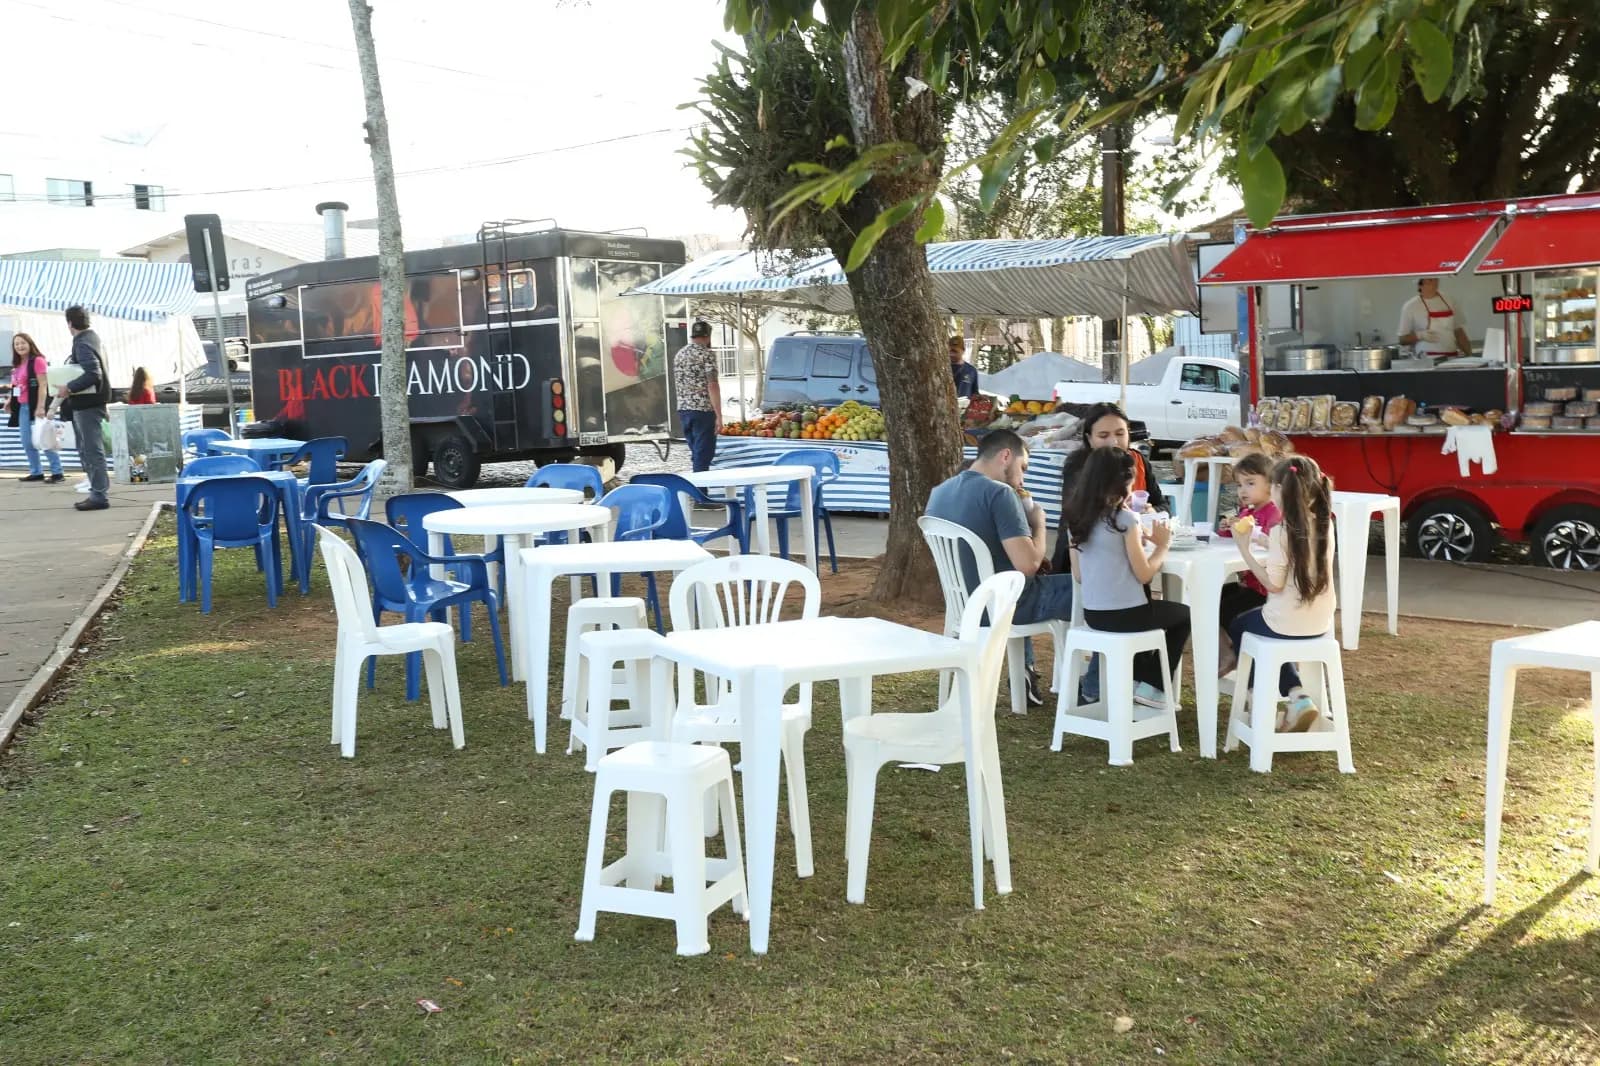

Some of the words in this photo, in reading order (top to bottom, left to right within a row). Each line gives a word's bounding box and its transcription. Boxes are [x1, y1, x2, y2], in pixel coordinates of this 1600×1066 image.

[1496, 298, 1530, 311] 0004
[277, 363, 370, 400] BLACK
[372, 353, 531, 397] AMOND
